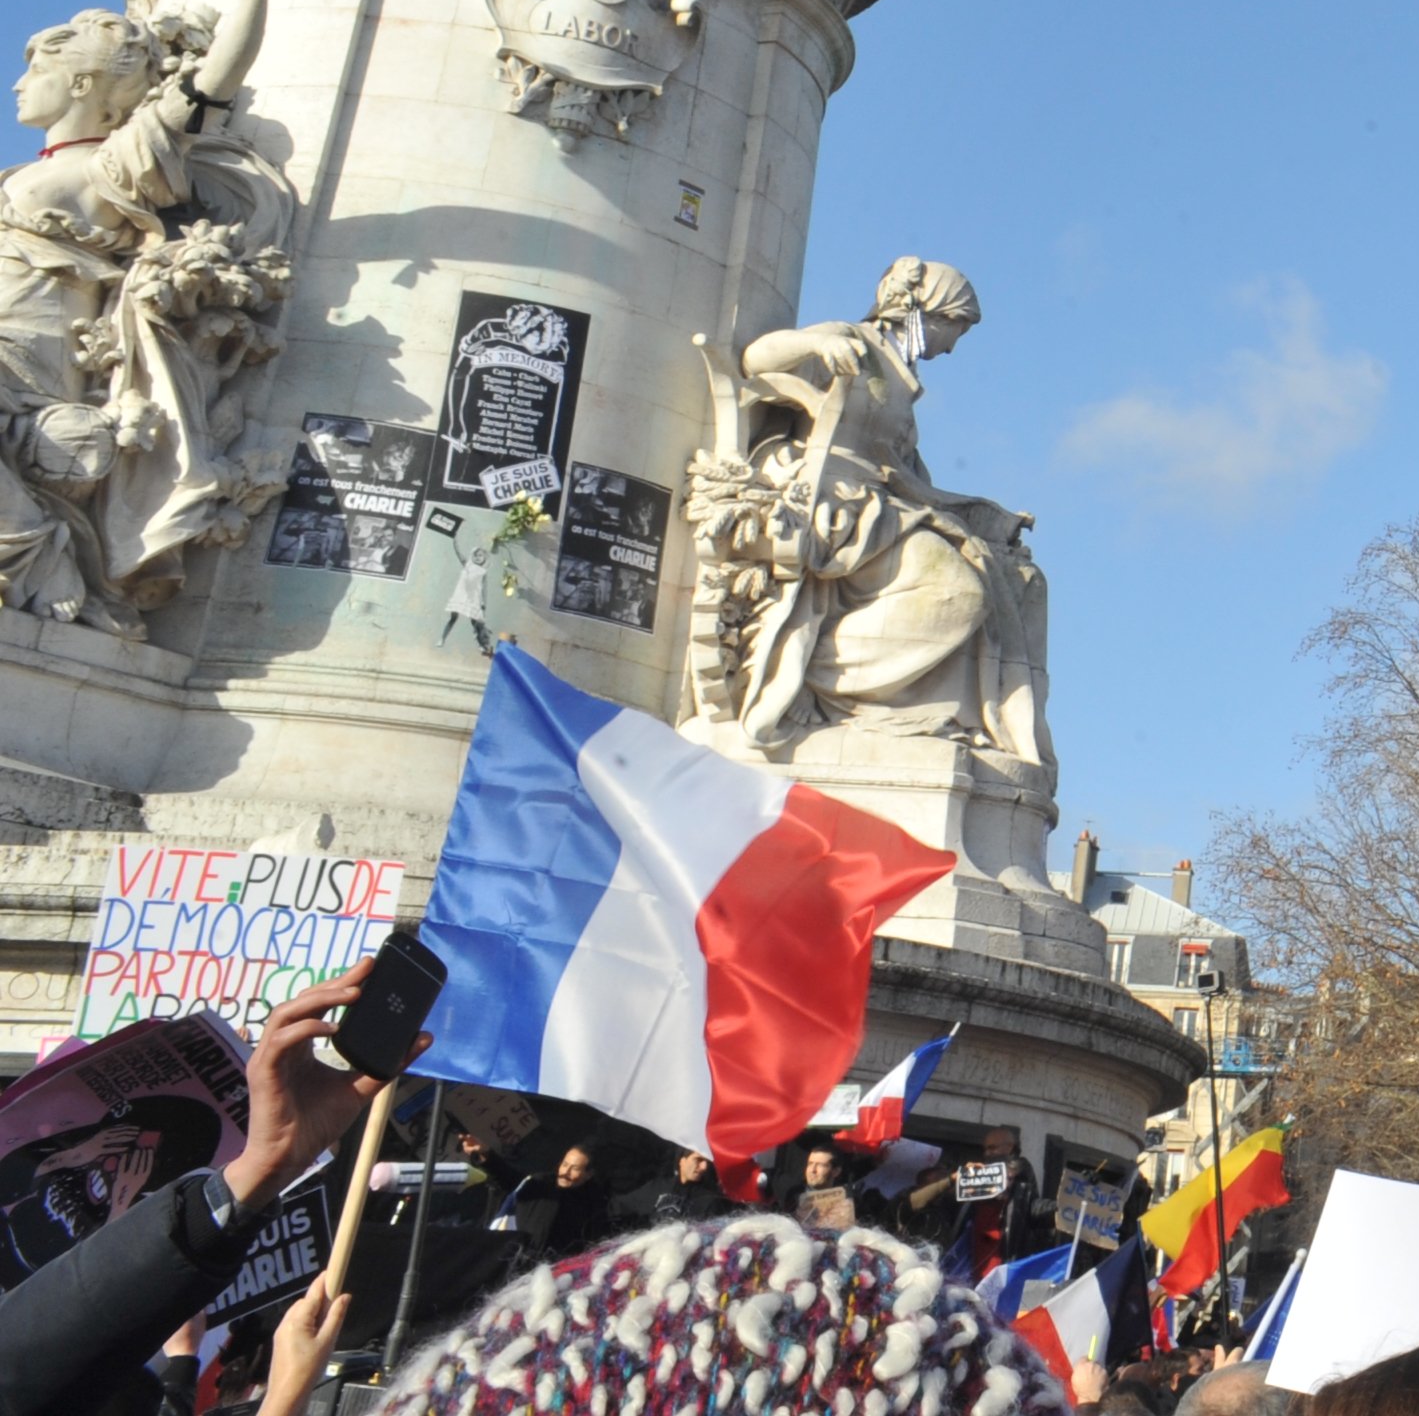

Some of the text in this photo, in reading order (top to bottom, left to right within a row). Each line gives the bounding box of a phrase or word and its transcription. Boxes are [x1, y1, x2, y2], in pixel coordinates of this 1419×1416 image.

[540, 10, 639, 57] LABOR
[491, 462, 549, 485] JE SUIS
[493, 474, 554, 500] CHARLIE
[354, 480, 418, 500] franchement
[343, 492, 416, 518] CHARLIE
[608, 544, 658, 573] CHARLIE
[91, 887, 396, 971] DÉMOCRATIE
[84, 950, 279, 1006] PARTOUT
